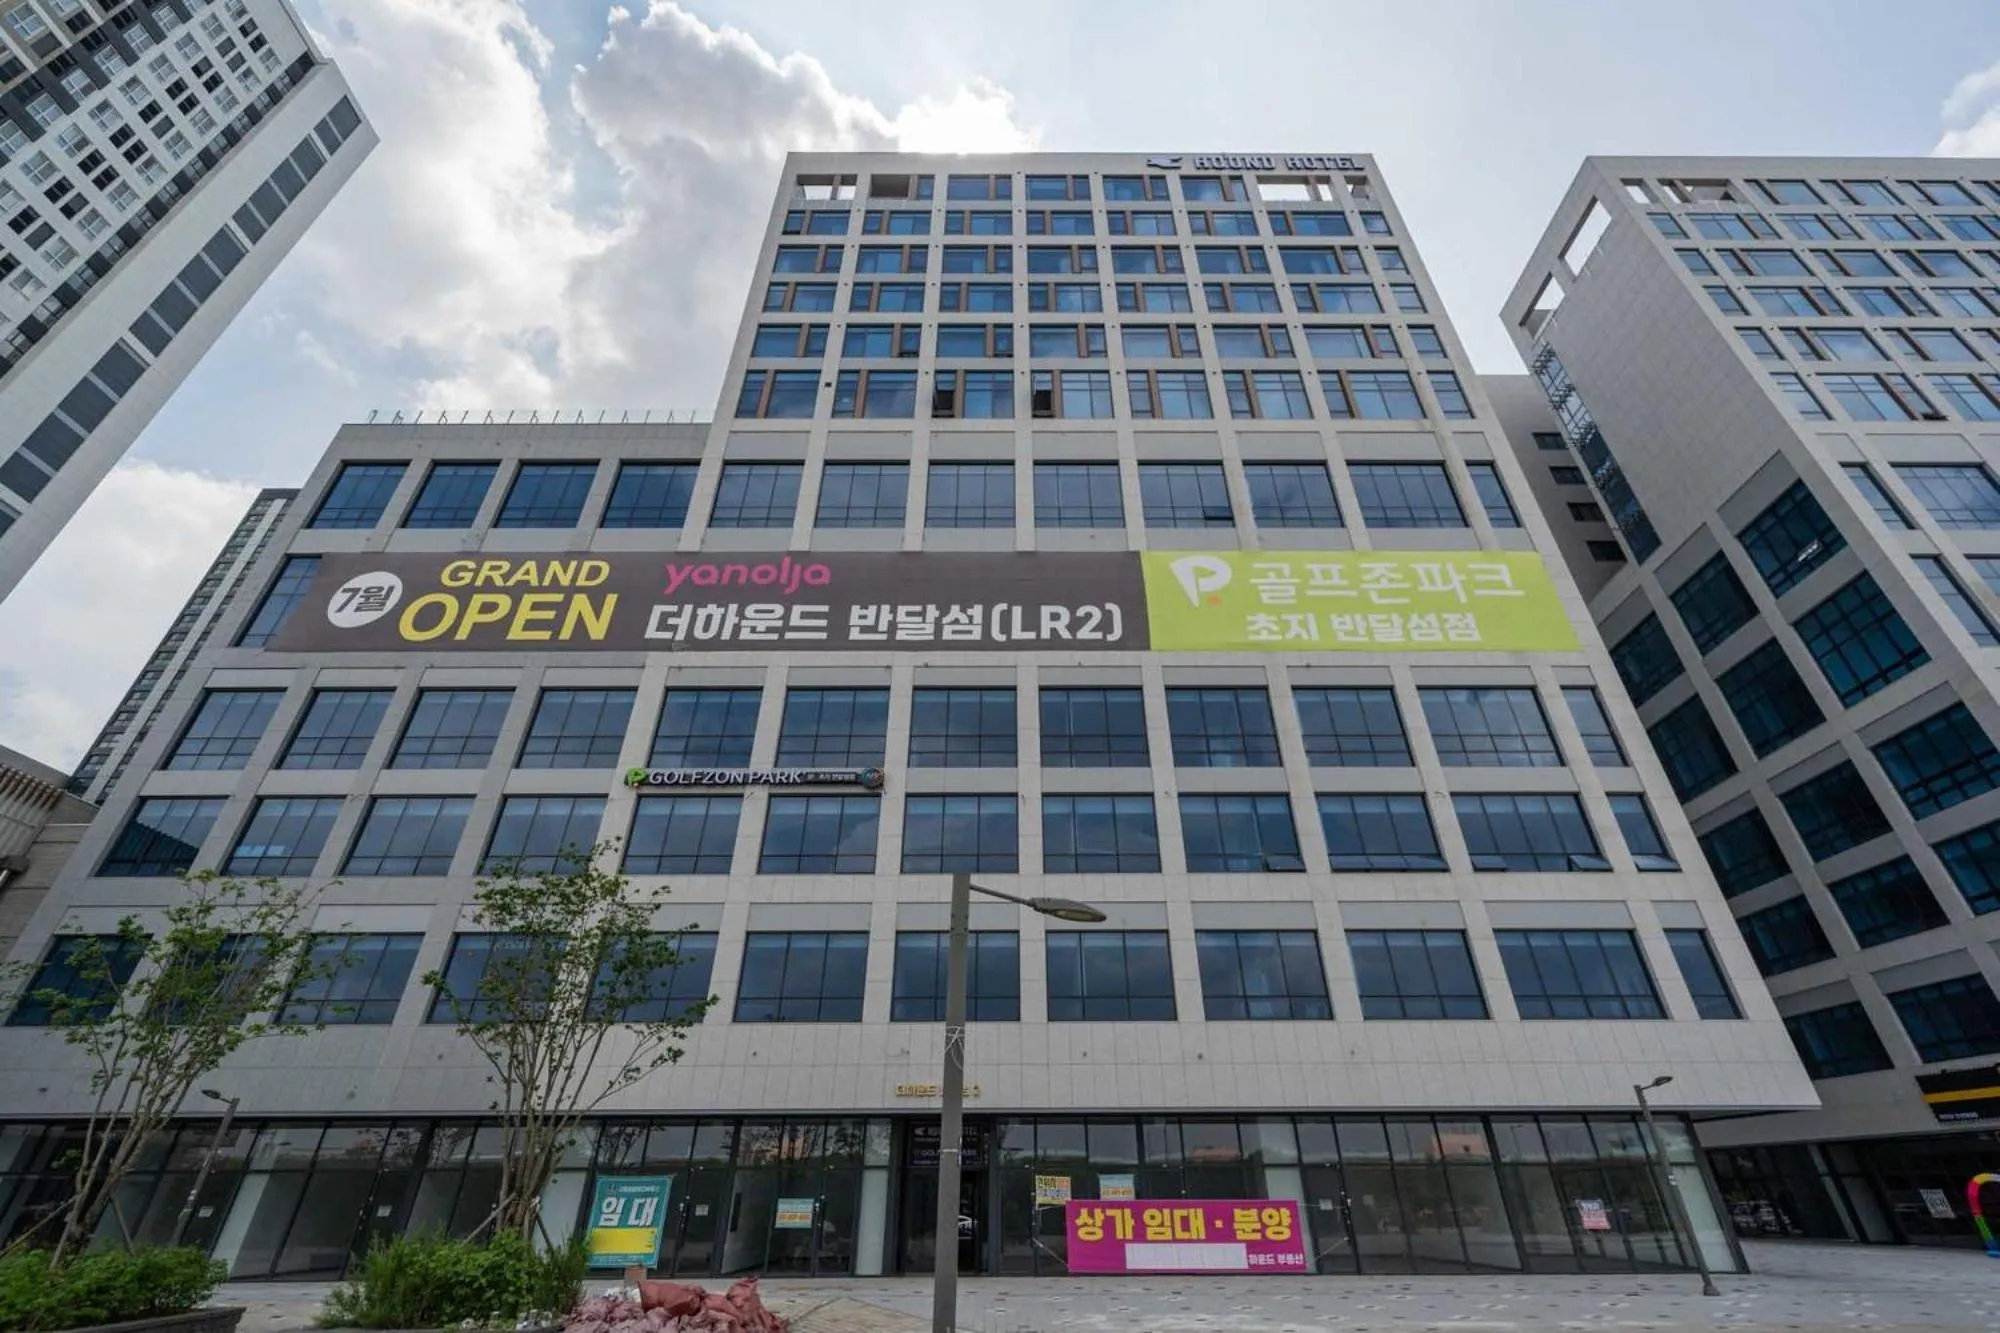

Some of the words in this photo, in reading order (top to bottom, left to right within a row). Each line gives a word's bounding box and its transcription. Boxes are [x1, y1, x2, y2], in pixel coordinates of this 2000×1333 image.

[1286, 153, 1366, 171] HOTEL
[439, 559, 611, 589] GRAND
[663, 555, 832, 595] yanolja
[1249, 562, 1526, 604] 골프존파크
[338, 585, 399, 614] 7월
[399, 593, 618, 642] OPEN
[643, 603, 830, 641] 더하운드
[848, 603, 1123, 642] 반달섬(LR2)
[1245, 613, 1321, 642] 초지
[1330, 612, 1483, 642] 반달섬점
[649, 768, 746, 785] GOLFZON
[748, 767, 802, 784] PARK
[1075, 1207, 1136, 1241] 상가
[1143, 1207, 1207, 1241] 임대
[1233, 1207, 1293, 1241] 분양
